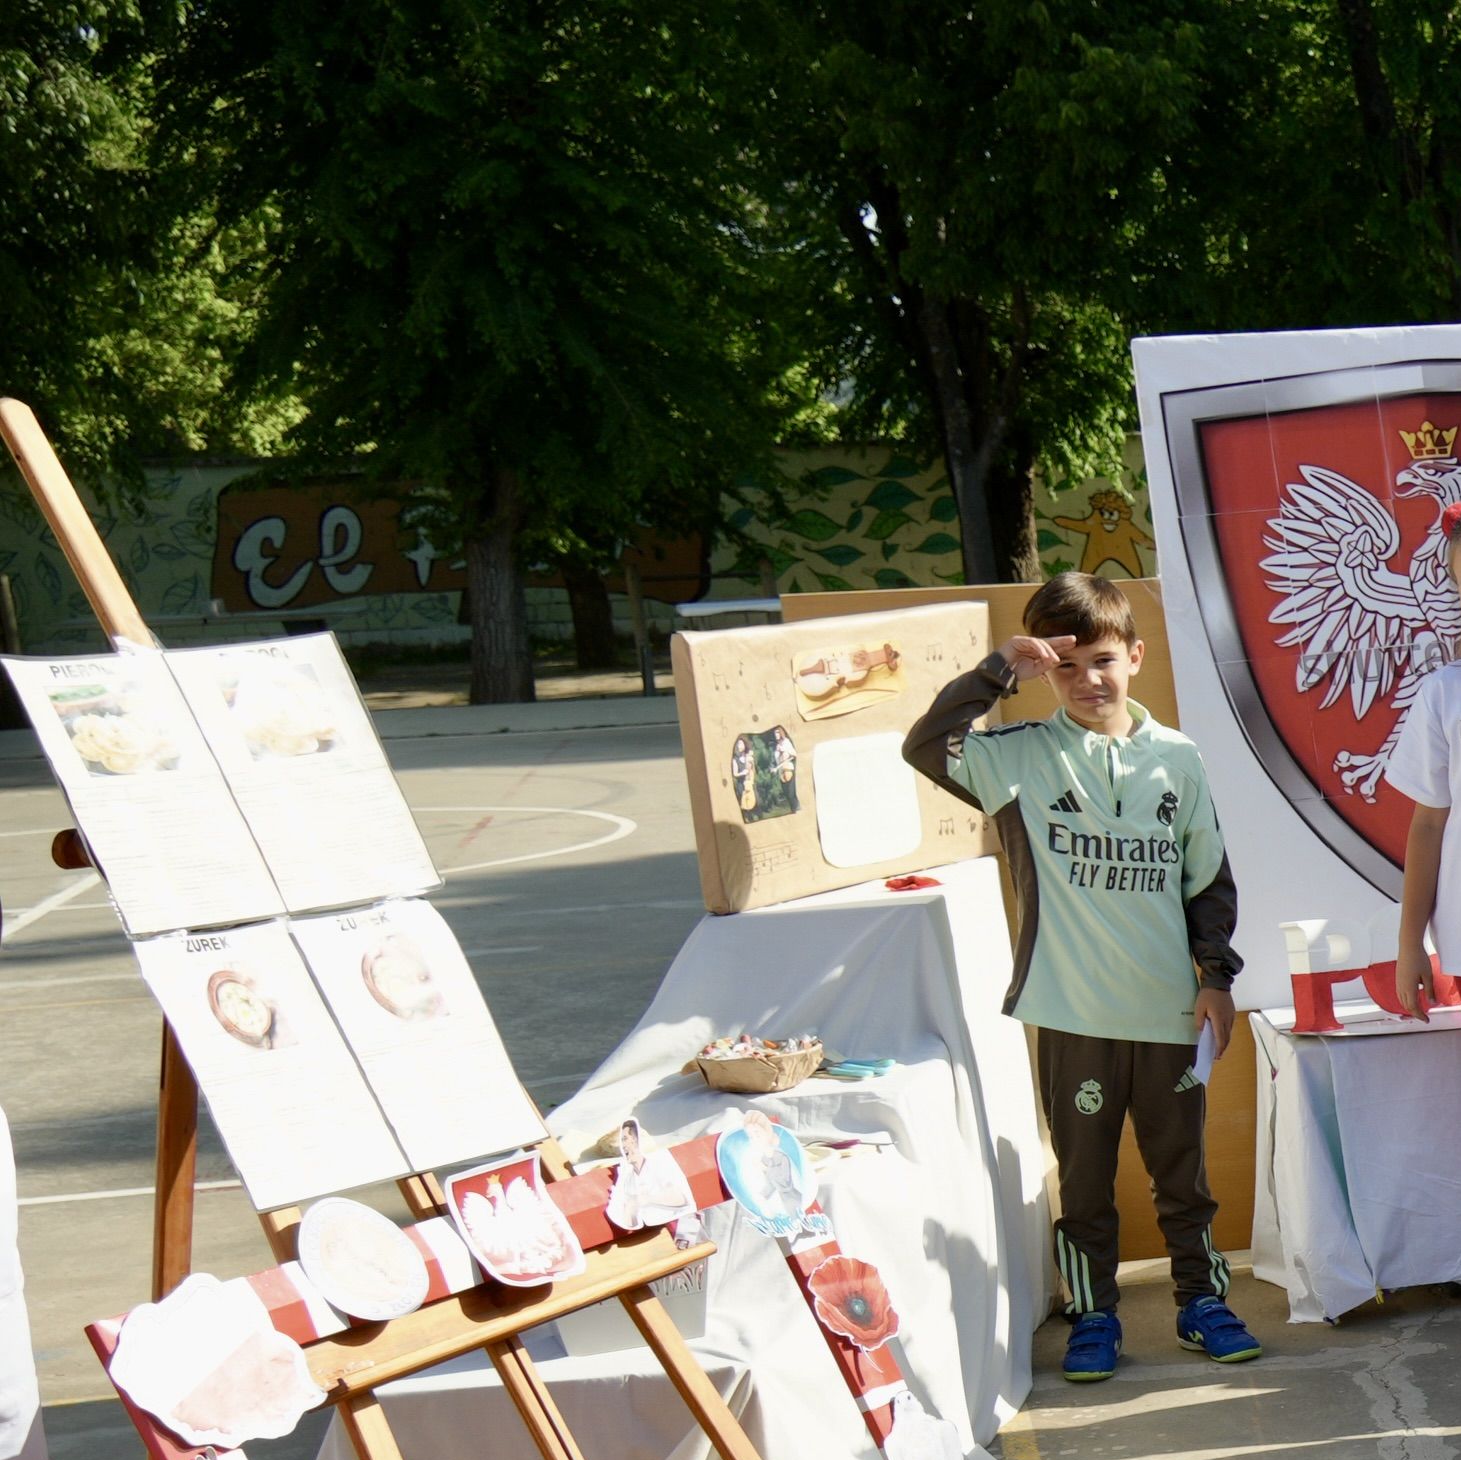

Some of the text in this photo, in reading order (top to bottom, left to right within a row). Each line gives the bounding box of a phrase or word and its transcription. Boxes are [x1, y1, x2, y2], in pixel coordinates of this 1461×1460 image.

[233, 504, 375, 608] El
[1047, 821, 1181, 864] Emirates
[1068, 861, 1167, 893] FLY BETTER
